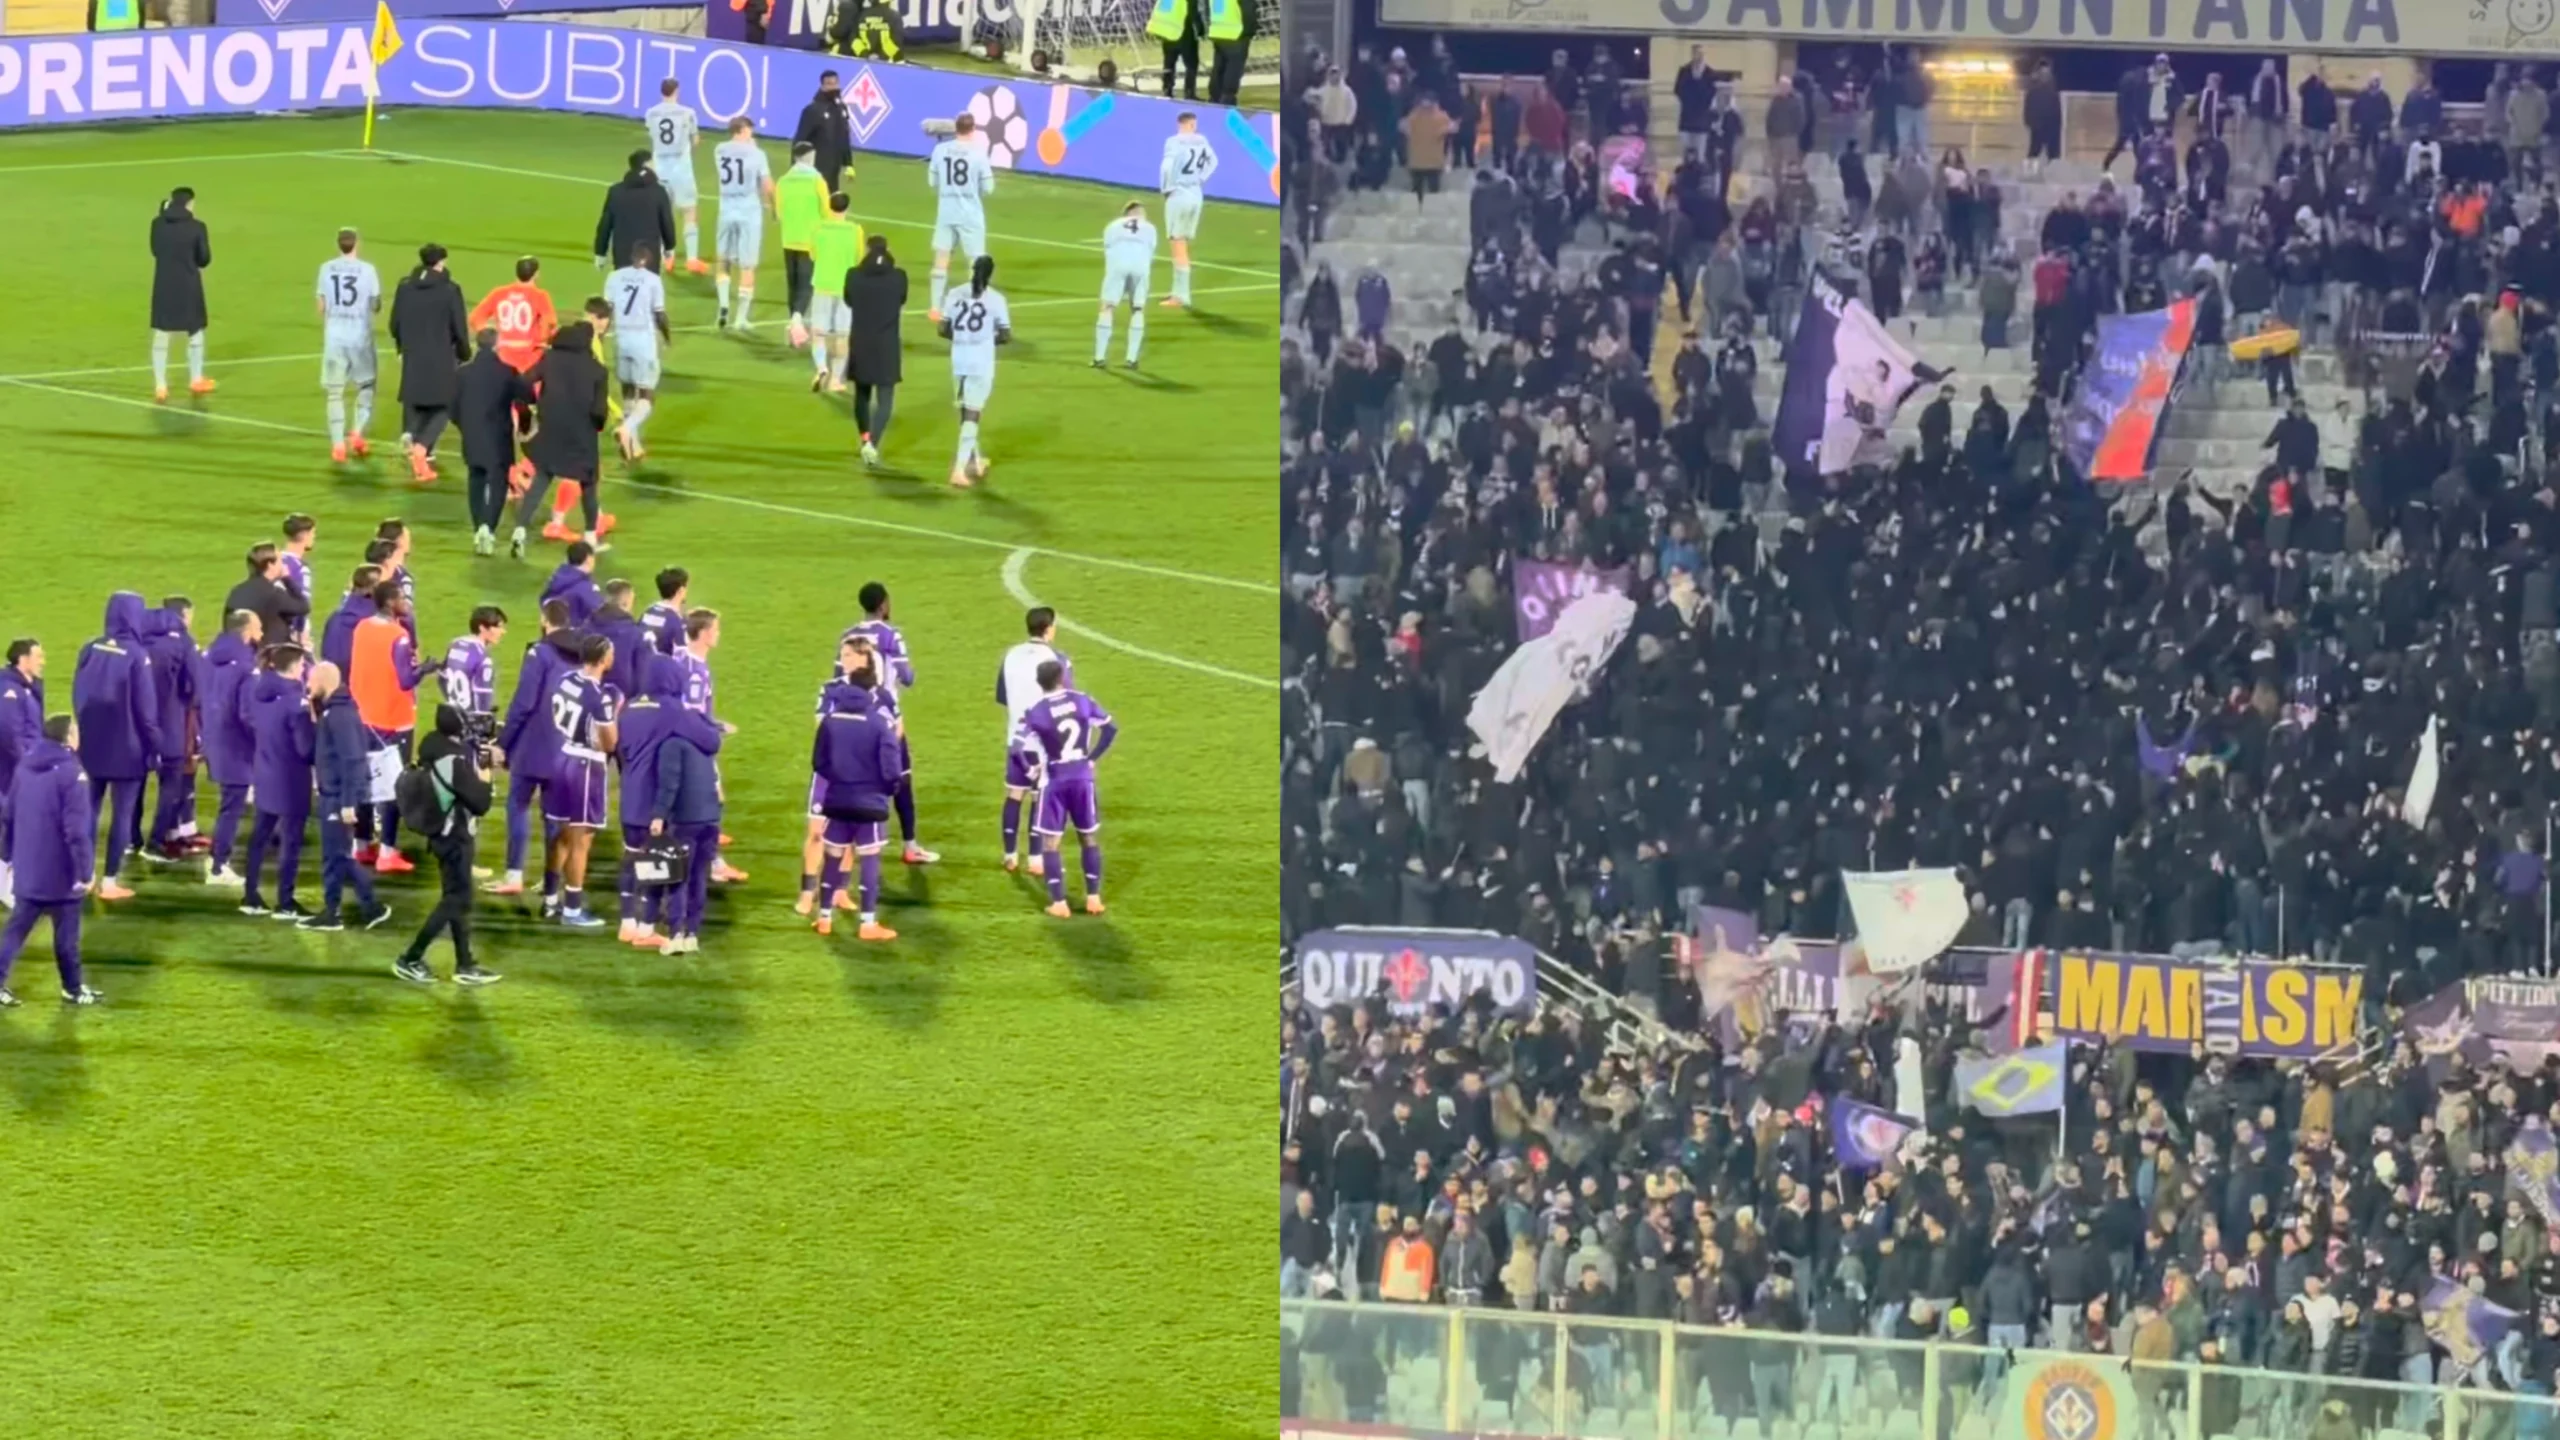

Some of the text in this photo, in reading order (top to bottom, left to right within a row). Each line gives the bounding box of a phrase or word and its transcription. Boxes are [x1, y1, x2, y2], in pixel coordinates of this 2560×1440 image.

[411, 25, 769, 128] SUBITO!
[659, 118, 674, 145] 8
[721, 156, 744, 185] 31
[943, 156, 969, 187] 18
[1181, 147, 1211, 175] 24
[1122, 218, 1139, 234] 4
[330, 274, 358, 307] 13
[622, 284, 639, 316] 7
[497, 300, 532, 333] 90
[953, 300, 987, 332] 28
[1057, 718, 1084, 761] 2
